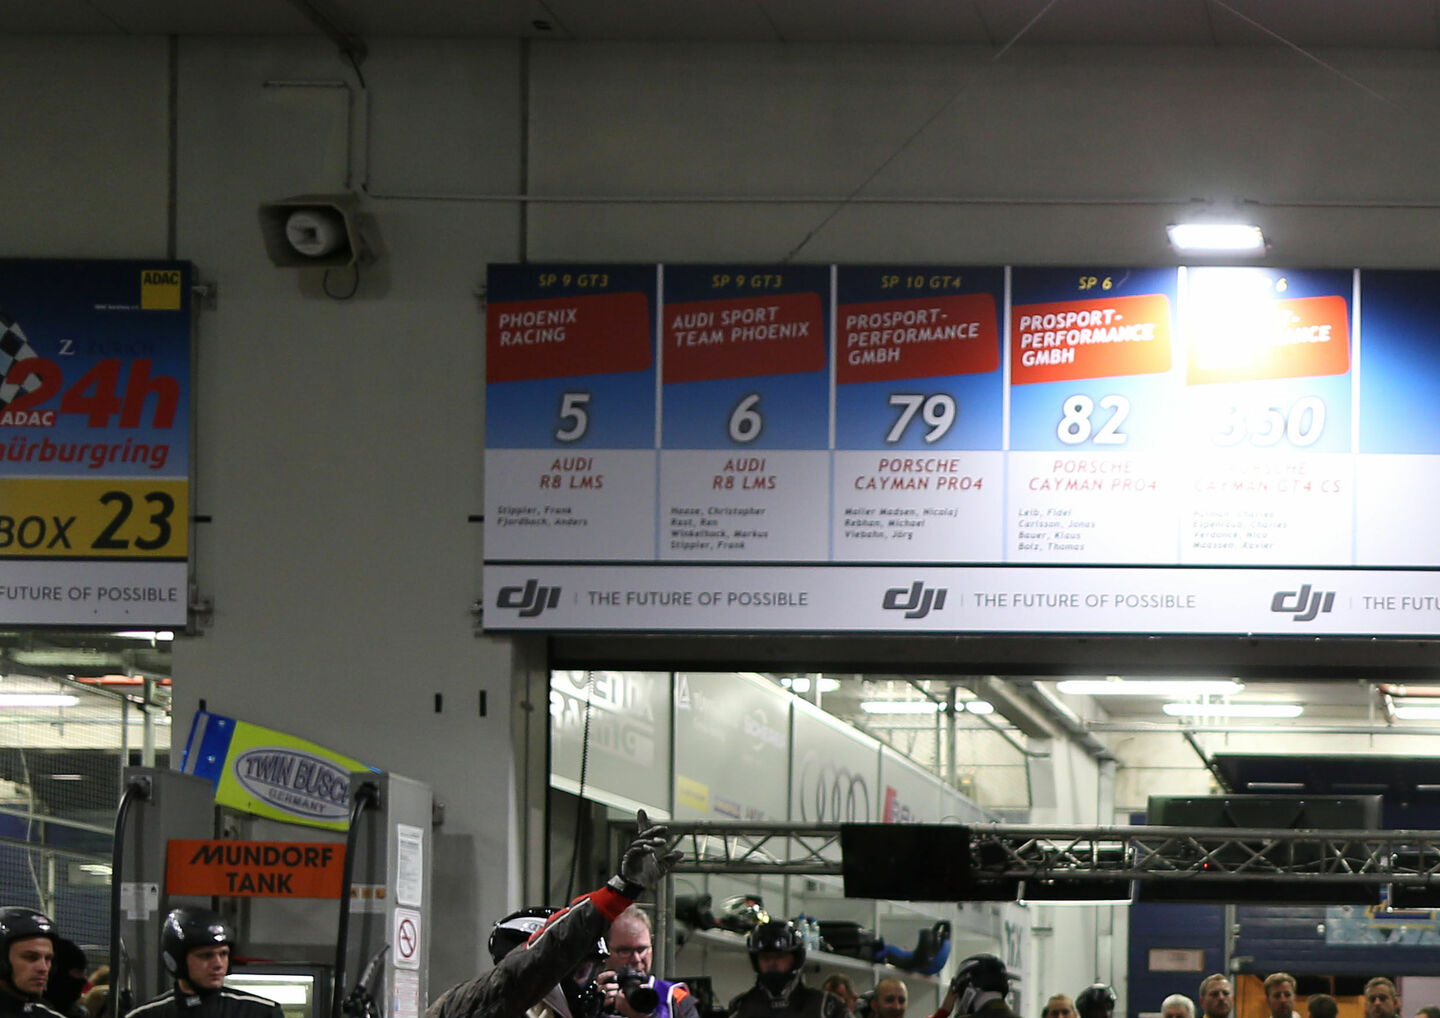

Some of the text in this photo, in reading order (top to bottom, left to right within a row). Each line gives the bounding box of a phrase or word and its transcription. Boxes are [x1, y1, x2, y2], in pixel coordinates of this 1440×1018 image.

[143, 272, 179, 285] ADAC
[538, 274, 609, 288] SP 9 GT3
[712, 275, 783, 288] SP 9 GT3
[881, 275, 962, 289] SP 10 GT4
[1078, 276, 1113, 290] SP 6
[499, 308, 577, 329] PHOENIX
[673, 307, 779, 329] AUDI SPORT
[846, 309, 948, 330] PROSPORT-
[1020, 309, 1123, 332] PROSPORT-
[500, 327, 567, 347] RACING
[675, 321, 810, 348] TEAM PHOENIX
[847, 322, 980, 349] PERFORMANCE
[1021, 322, 1155, 349] PERFORMANCE
[848, 348, 902, 366] GMBH
[1022, 348, 1075, 367] GMBH
[2, 358, 180, 429] 24h
[1, 411, 54, 427] ADAC
[554, 393, 590, 442] 5
[728, 393, 763, 443] 6
[886, 394, 958, 444] 79
[1056, 394, 1131, 446] 82
[550, 458, 593, 473] AUDI
[723, 458, 766, 473] AUDI
[878, 458, 960, 473] PORSCHE
[1052, 459, 1132, 475] PORSCHE
[539, 475, 604, 490] R8 LMS
[712, 475, 777, 490] R8 LMS
[854, 476, 984, 491] CAYMAN PRO4
[1028, 477, 1103, 492] CAYMAN
[1321, 479, 1341, 493] CS
[91, 491, 175, 550] 23
[68, 587, 92, 601] OF
[98, 587, 178, 602] POSSIBLE
[588, 591, 809, 606] THE FUTURE OF POSSIBLE
[974, 593, 1197, 609] THE FUTURE OF POSSIBLE
[1363, 596, 1396, 610] THE
[246, 755, 296, 787] TWIN
[268, 788, 327, 813] GERMANY
[189, 845, 334, 868] MUNDORF
[226, 872, 293, 894] TANK
